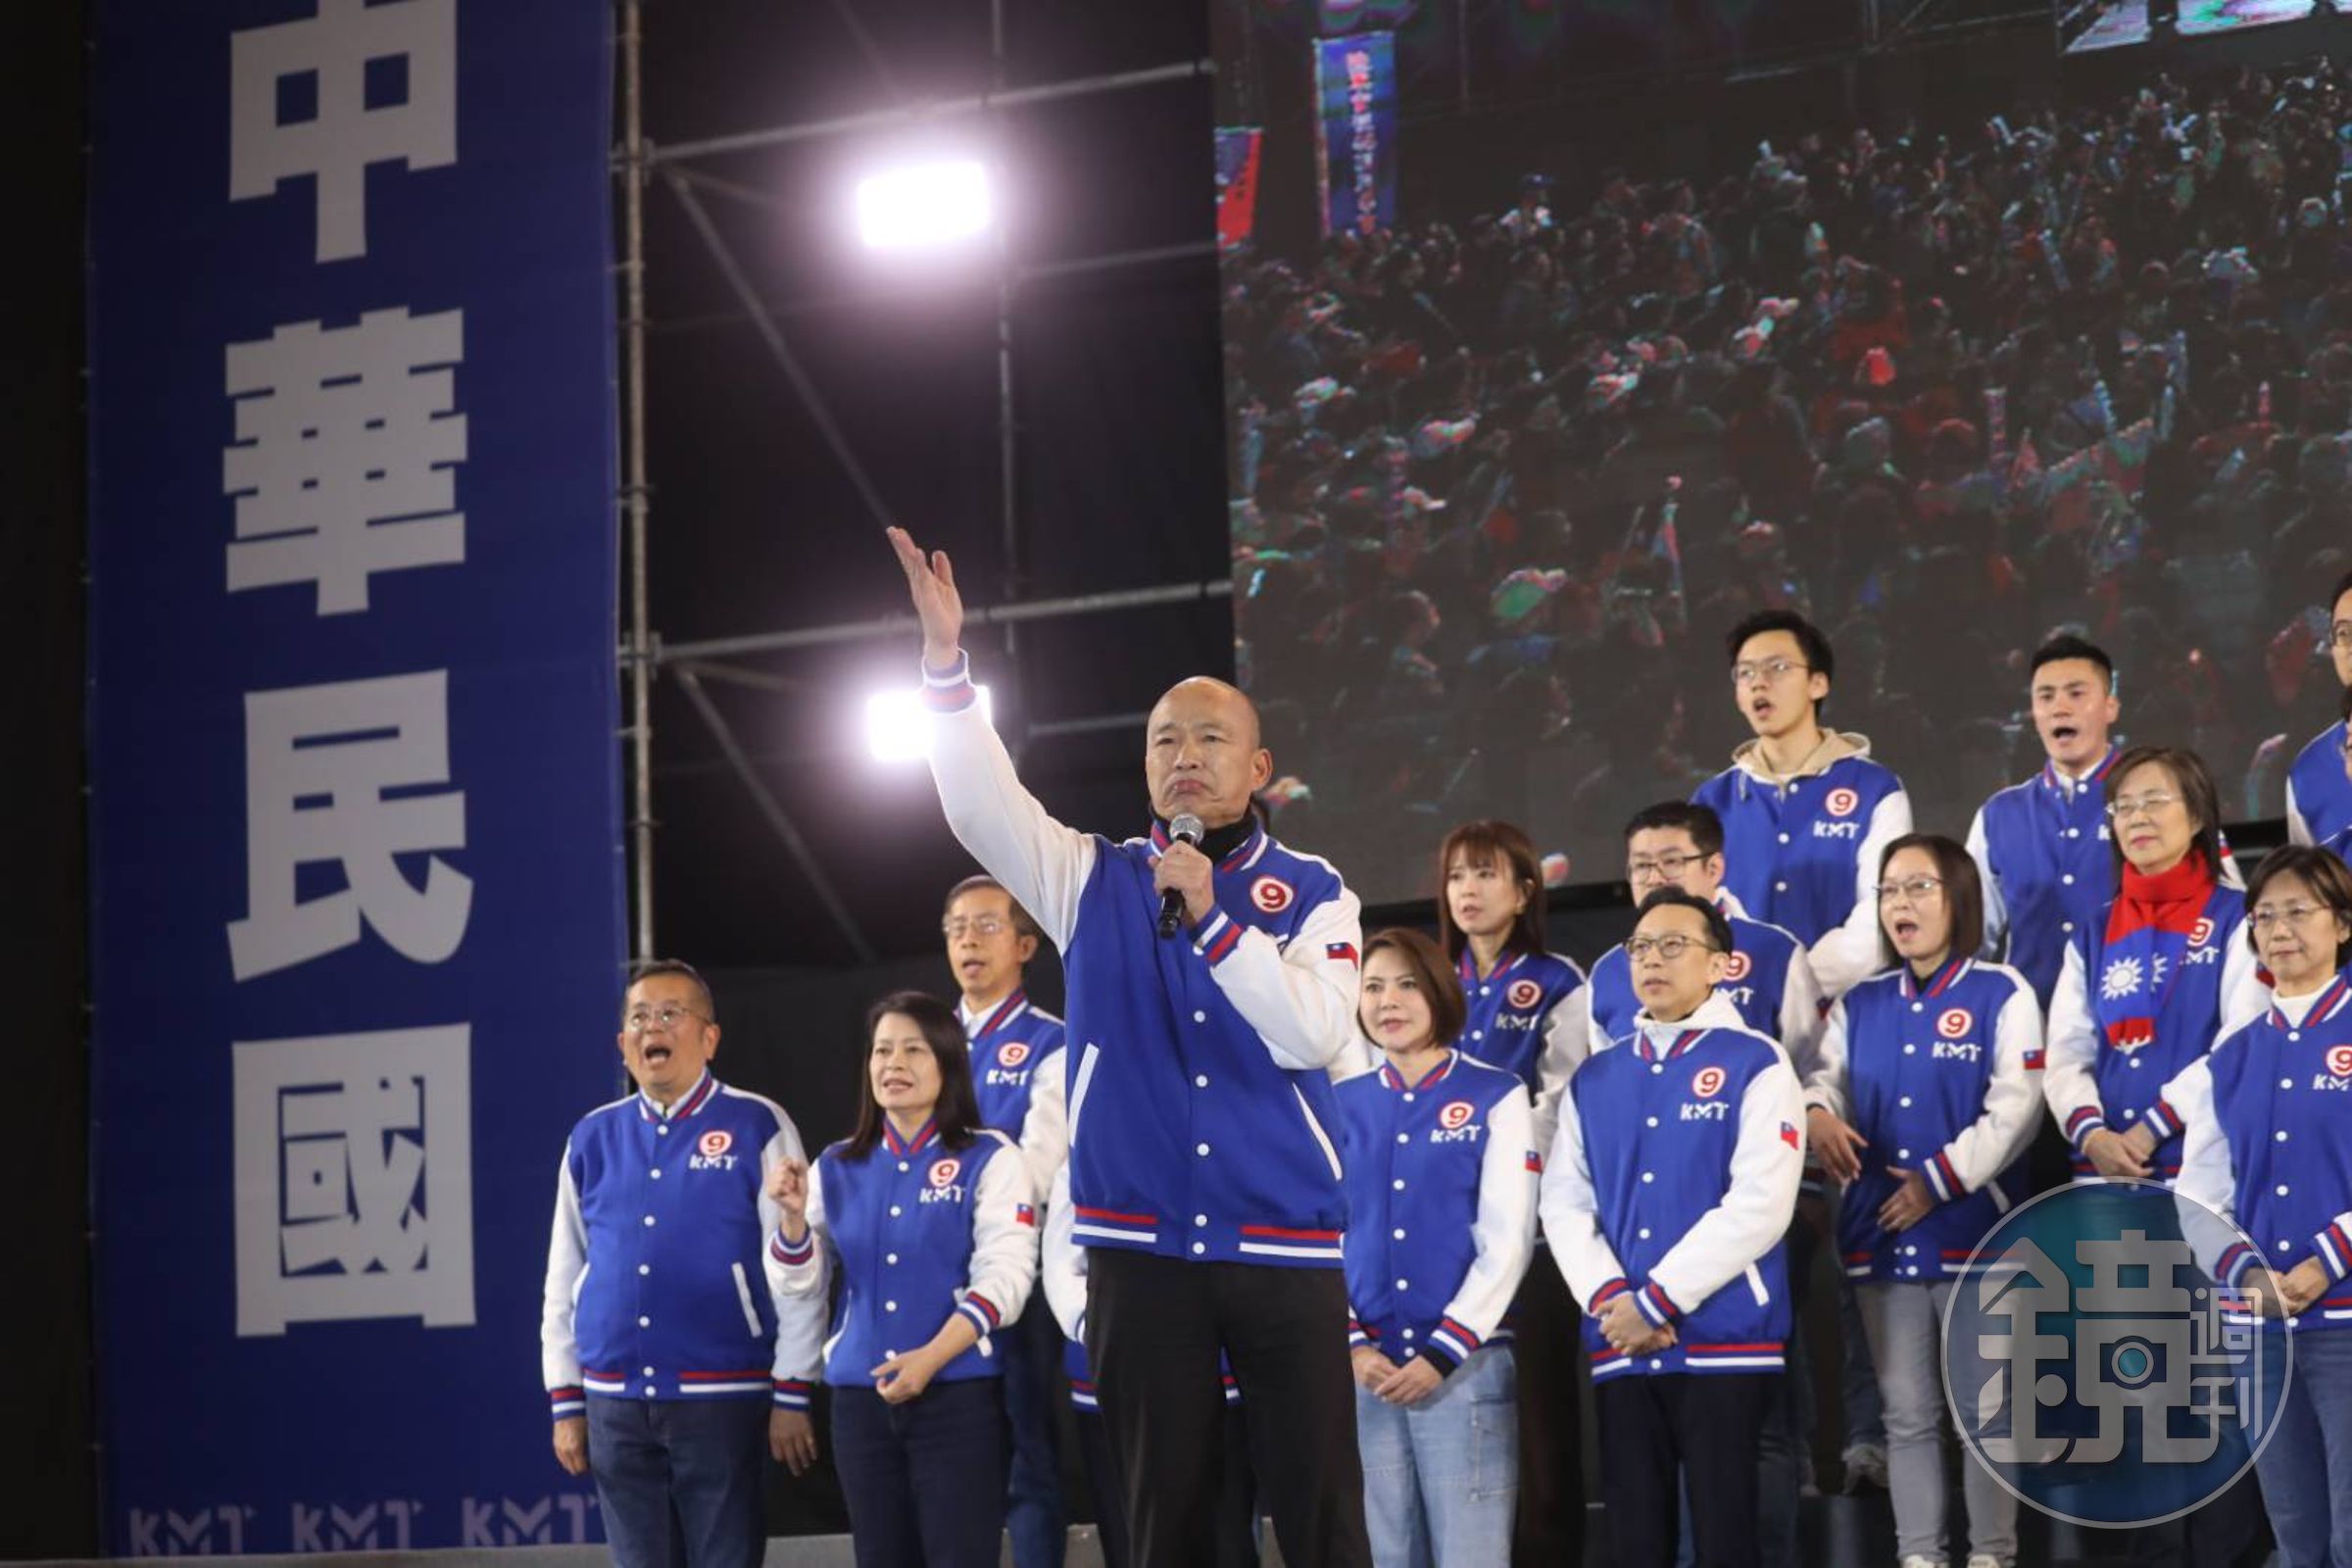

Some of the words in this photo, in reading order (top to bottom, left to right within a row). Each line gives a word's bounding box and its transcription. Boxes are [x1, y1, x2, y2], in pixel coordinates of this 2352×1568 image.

[223, 0, 476, 1338] 中華民國
[1812, 820, 1860, 839] KMT
[2185, 946, 2220, 964] MT
[1495, 1012, 1540, 1030] KMT
[1932, 1041, 1982, 1062] KMT
[986, 1068, 1030, 1087] KMT
[2312, 1073, 2350, 1092] KM
[1680, 1101, 1730, 1121] KMT
[1430, 1124, 1482, 1144] KMT
[688, 1153, 738, 1171] KMT
[918, 1187, 966, 1203] KMT
[129, 1504, 257, 1557] KMT
[291, 1497, 424, 1552] KMT
[461, 1493, 602, 1547] KMT
